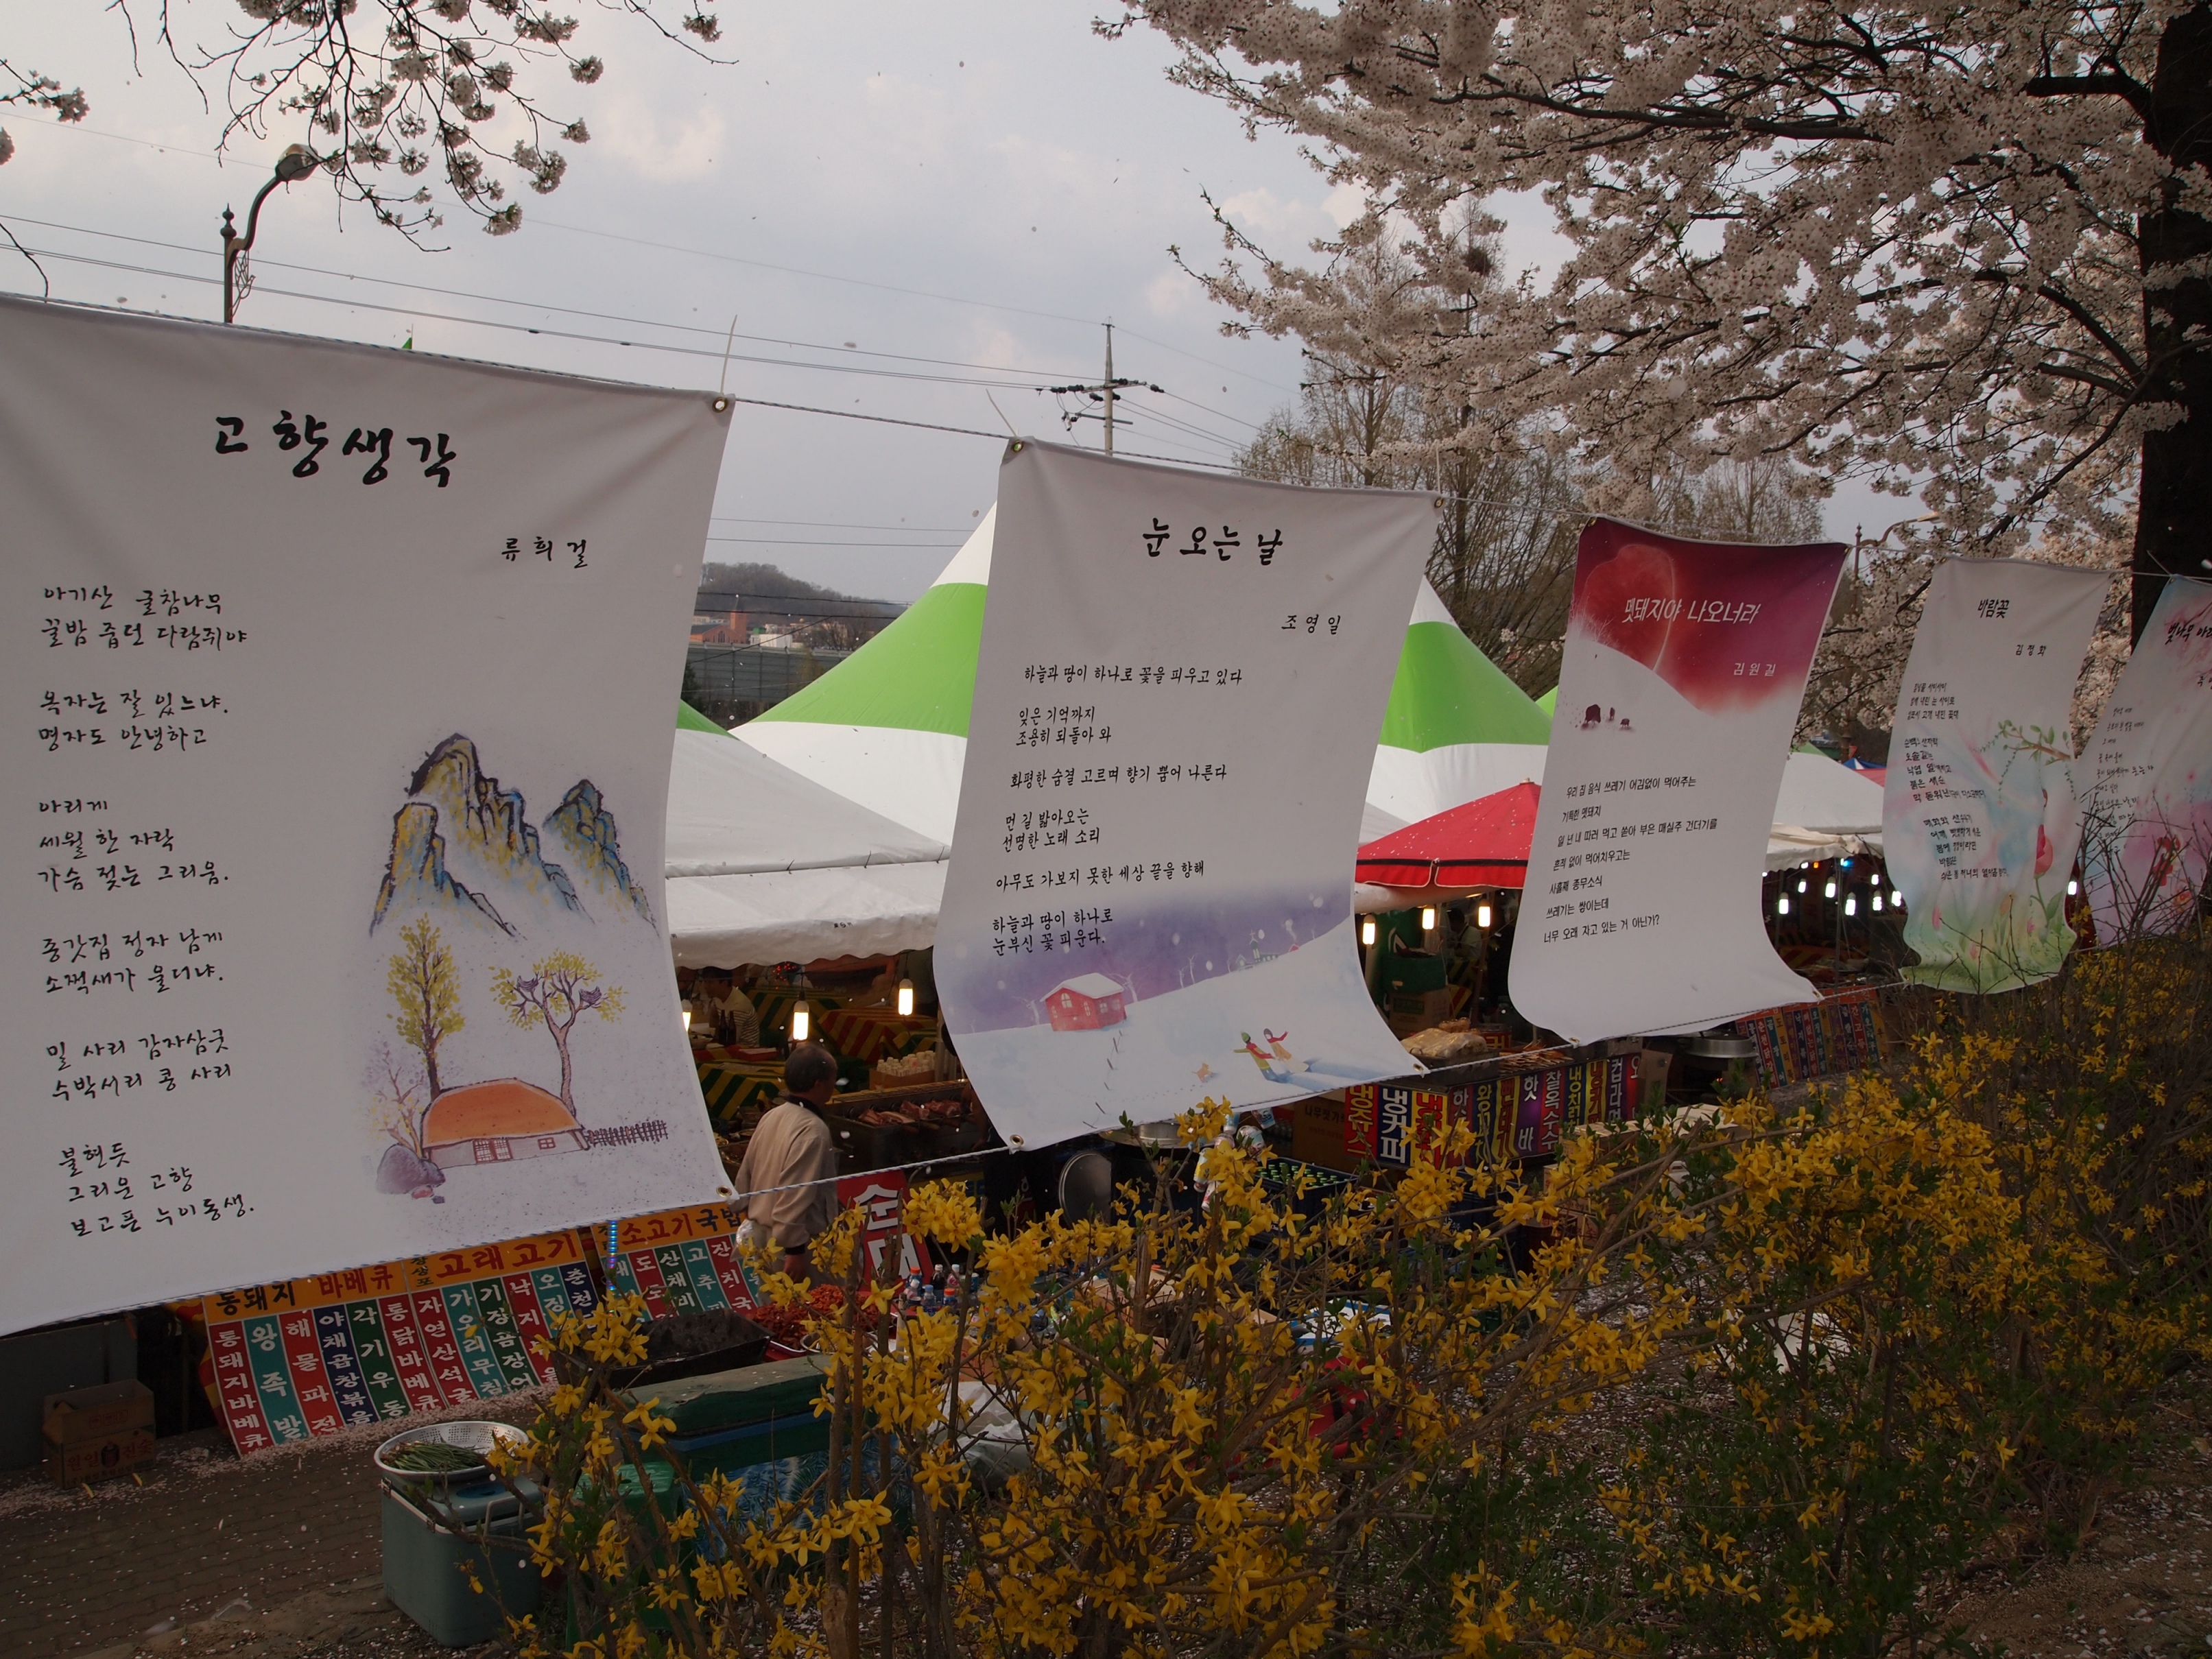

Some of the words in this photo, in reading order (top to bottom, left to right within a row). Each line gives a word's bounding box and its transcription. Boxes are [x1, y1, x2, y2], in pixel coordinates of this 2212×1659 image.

[215, 409, 457, 488] 고향생각
[1142, 517, 1170, 558] 눈
[1179, 525, 1241, 562] 오는
[1257, 529, 1283, 566] 날
[45, 585, 113, 610] 아기산
[1622, 597, 1683, 623] 멧돼지야
[1687, 599, 1761, 624] 나오너라
[1977, 599, 2010, 619] 바람꽃
[41, 618, 87, 648] 꿀밤
[99, 622, 144, 649] 줍던
[157, 624, 248, 652] 다람쥐야
[1025, 665, 1058, 684] 하늘과
[1064, 665, 1087, 683] 땅이
[1094, 665, 1132, 682] 하나로
[1139, 666, 1165, 684] 꽃을
[1170, 667, 1209, 684] 피우고
[1216, 669, 1242, 685] 있다
[40, 691, 108, 715] 옥자는
[120, 689, 145, 719] 잘
[155, 692, 228, 719] 있느냐.
[1019, 707, 1041, 727] 잊은
[1047, 706, 1095, 724] 기억까지
[38, 726, 106, 752] 명자도
[121, 725, 206, 752] 안녕하고
[1016, 727, 1050, 748] 조용히
[1056, 726, 1094, 745] 되돌아
[1099, 726, 1112, 743] 와
[1010, 769, 1047, 789] 화평한
[1051, 767, 1075, 787] 숨결
[1080, 766, 1119, 783] 고르며
[1126, 765, 1150, 784] 향기
[1156, 765, 1181, 783] 뿜어
[1188, 764, 1227, 782] 나른다
[1566, 786, 1578, 799] 우리
[1579, 784, 1586, 797] 집
[1588, 782, 1602, 796] 음식
[1604, 780, 1626, 793] 쓰레기
[1629, 778, 1661, 790] 어김없이
[1664, 776, 1696, 788] 먹어주는
[39, 798, 108, 813] 아리게
[1006, 813, 1016, 832] 먼
[1022, 811, 1032, 830] 길
[1038, 808, 1089, 828] 밟아오는
[1562, 809, 1580, 822] 기특한
[1581, 805, 1602, 820] 멧돼지
[39, 831, 88, 860] 세월
[95, 828, 119, 855] 한
[130, 828, 174, 852] 자락
[1003, 831, 1039, 853] 선명한
[1043, 828, 1068, 846] 노래
[1075, 826, 1099, 844] 소리
[1602, 827, 1617, 839] 먹고
[1621, 825, 1637, 838] 쏟아
[1639, 823, 1655, 835] 부은
[1658, 821, 1682, 833] 매실주
[1685, 818, 1717, 832] 건더기를
[996, 873, 1034, 891] 아무도
[1041, 868, 1079, 887] 가보지
[1086, 866, 1113, 885] 못한
[1119, 864, 1145, 882] 세상
[1150, 861, 1175, 881] 끝을
[1181, 860, 1204, 879] 향해
[1553, 857, 1567, 872] 흔적
[1568, 855, 1582, 868] 없이
[1585, 849, 1630, 865] 먹어치우고는
[38, 867, 84, 892] 가슴
[96, 864, 141, 892] 젖는
[158, 861, 228, 885] 그리움.
[1549, 880, 1569, 894] 사흘째
[1573, 875, 1602, 891] 종무소식
[992, 914, 1034, 934] 하늘과
[1040, 910, 1065, 931] 땅이
[1073, 907, 1113, 925] 하나로
[1545, 903, 1575, 919] 쓰레기는
[1578, 898, 1609, 914] 쌓이는데
[992, 934, 1033, 957] 눈부신
[1040, 933, 1054, 951] 꽃
[1060, 927, 1105, 948] 피운다.
[1544, 930, 1559, 943] 너무
[1562, 927, 1578, 940] 오래
[1582, 924, 1597, 936] 자고
[1601, 921, 1617, 934] 있는
[1620, 918, 1628, 930] 거
[1632, 914, 1660, 928] 아닌가?
[42, 933, 110, 964] 종갓집
[121, 930, 169, 957] 정자
[179, 928, 223, 955] 남게
[46, 967, 136, 994] 소쩍새가
[46, 1041, 71, 1071] 밀
[83, 1040, 125, 1057] 사리
[138, 1028, 228, 1060] 감자삼굿
[52, 1073, 142, 1101] 수박서리
[158, 1068, 176, 1092] 콩
[191, 1063, 230, 1080] 사리
[1380, 1088, 1407, 1163] 냉커피
[1499, 1078, 1514, 1158] 뻔데기
[1542, 1071, 1561, 1149] 찰옥수수
[58, 1143, 130, 1178] 불현듯
[69, 1177, 134, 1202] 그리운
[150, 1167, 193, 1192] 고향
[71, 1210, 141, 1237] 보고픈
[156, 1193, 254, 1226] 누이동생.
[853, 1184, 922, 1279] 순대
[436, 1234, 580, 1279] 고래고기
[216, 1281, 296, 1316] 통돼지
[317, 1266, 394, 1299] 바베큐
[449, 1290, 502, 1396] 가오리무침
[480, 1284, 536, 1389] 기장곰장어
[319, 1313, 374, 1425] 야채곱창볶음
[353, 1306, 407, 1418] 각기우동
[383, 1302, 442, 1411] 통닭바베큐
[214, 1329, 267, 1448] 통돼지바베큐
[251, 1324, 301, 1440] 왕족발
[285, 1317, 337, 1435] 해물파전
